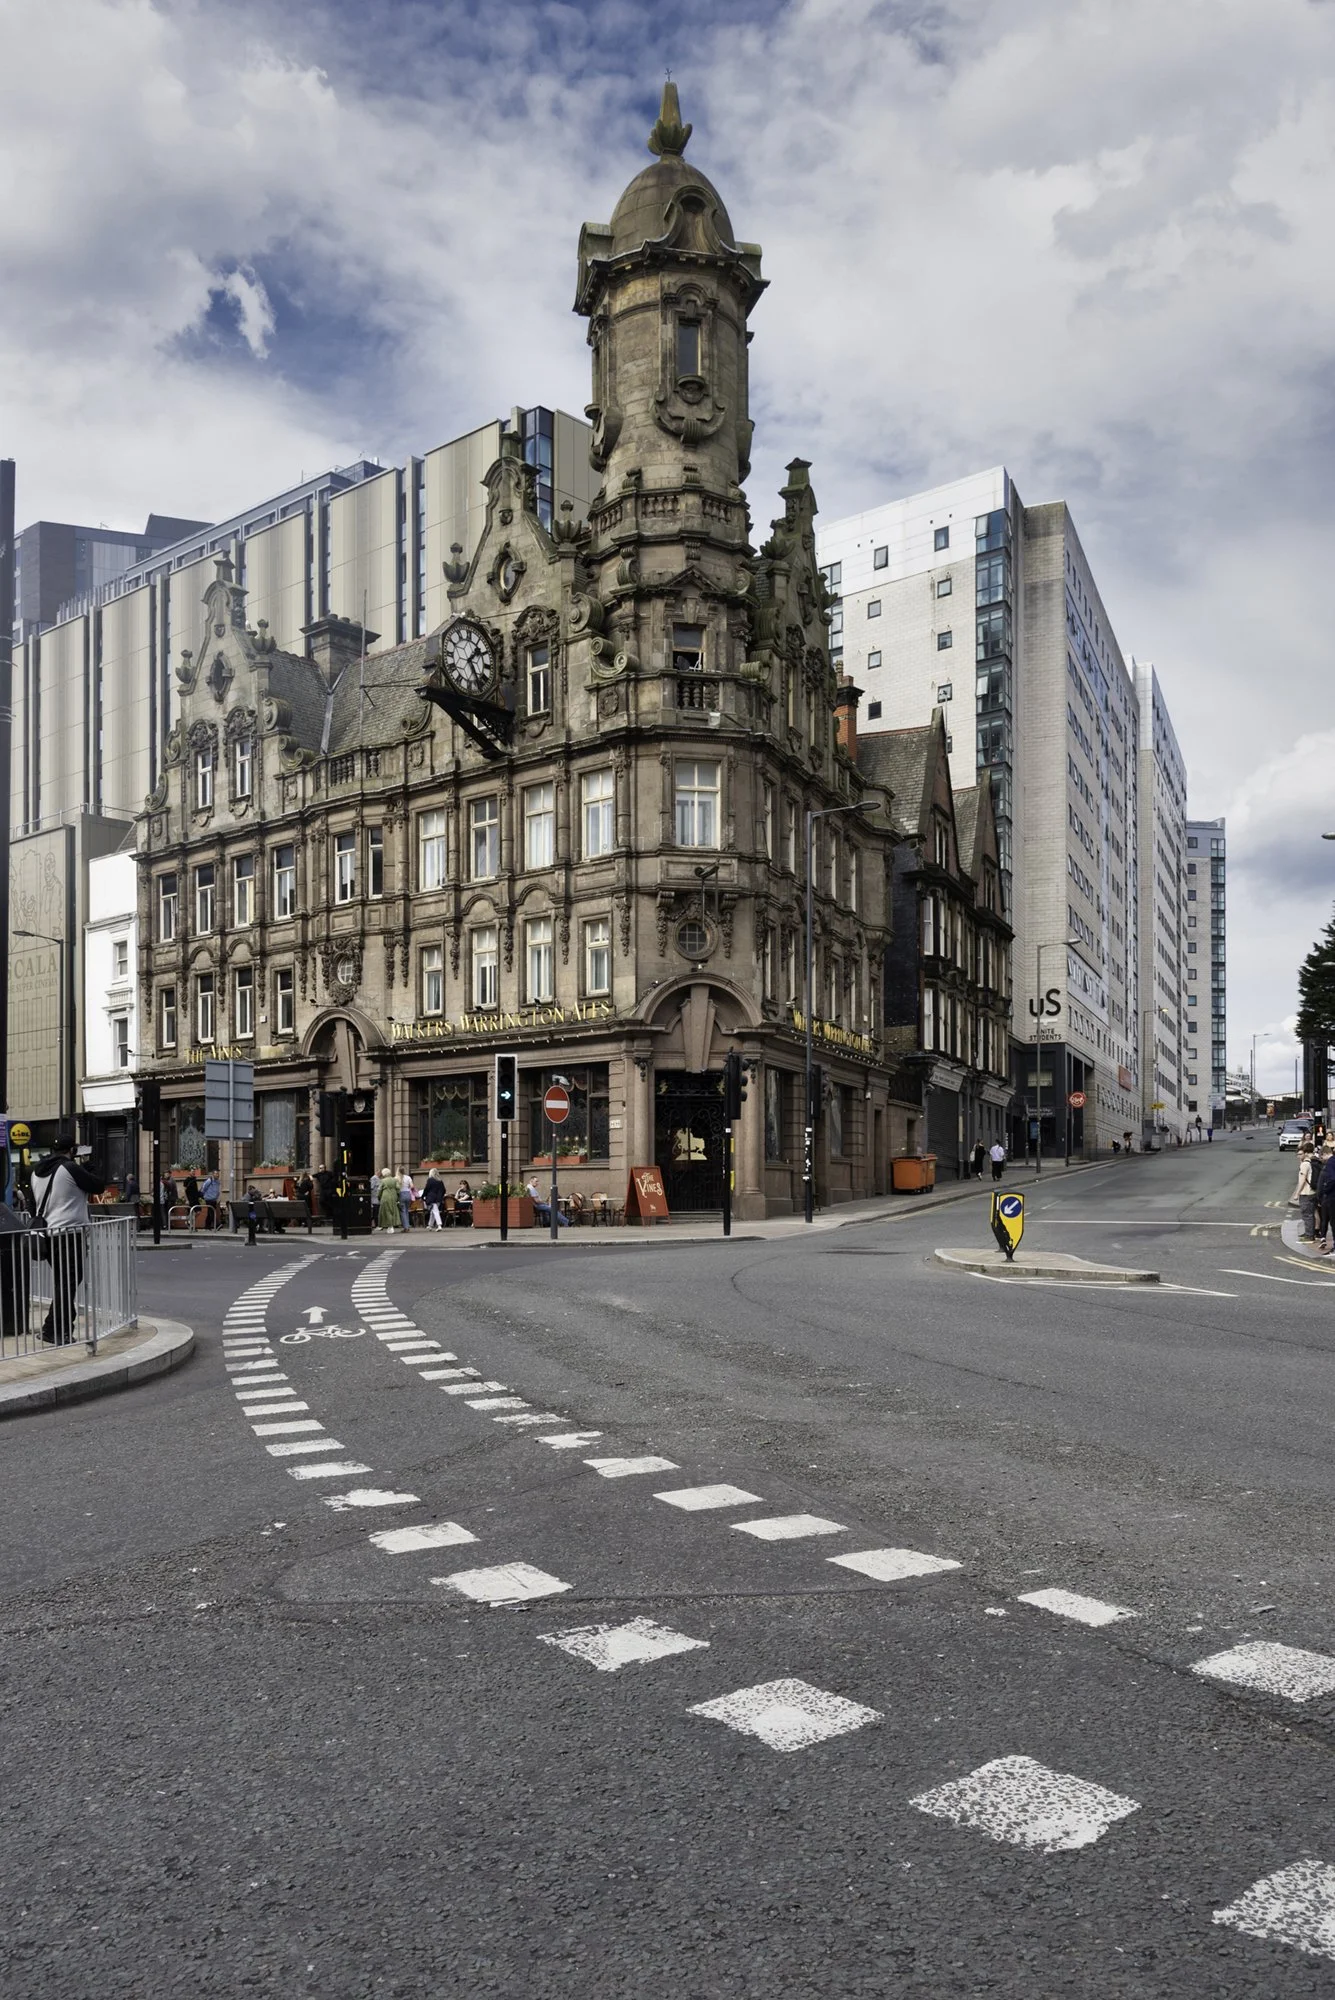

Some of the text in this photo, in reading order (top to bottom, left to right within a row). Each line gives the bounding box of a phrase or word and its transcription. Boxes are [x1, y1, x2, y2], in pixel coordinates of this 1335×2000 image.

[391, 1001, 610, 1039] WALKERS WARRINGTON ALES
[635, 1178, 663, 1198] VINES
